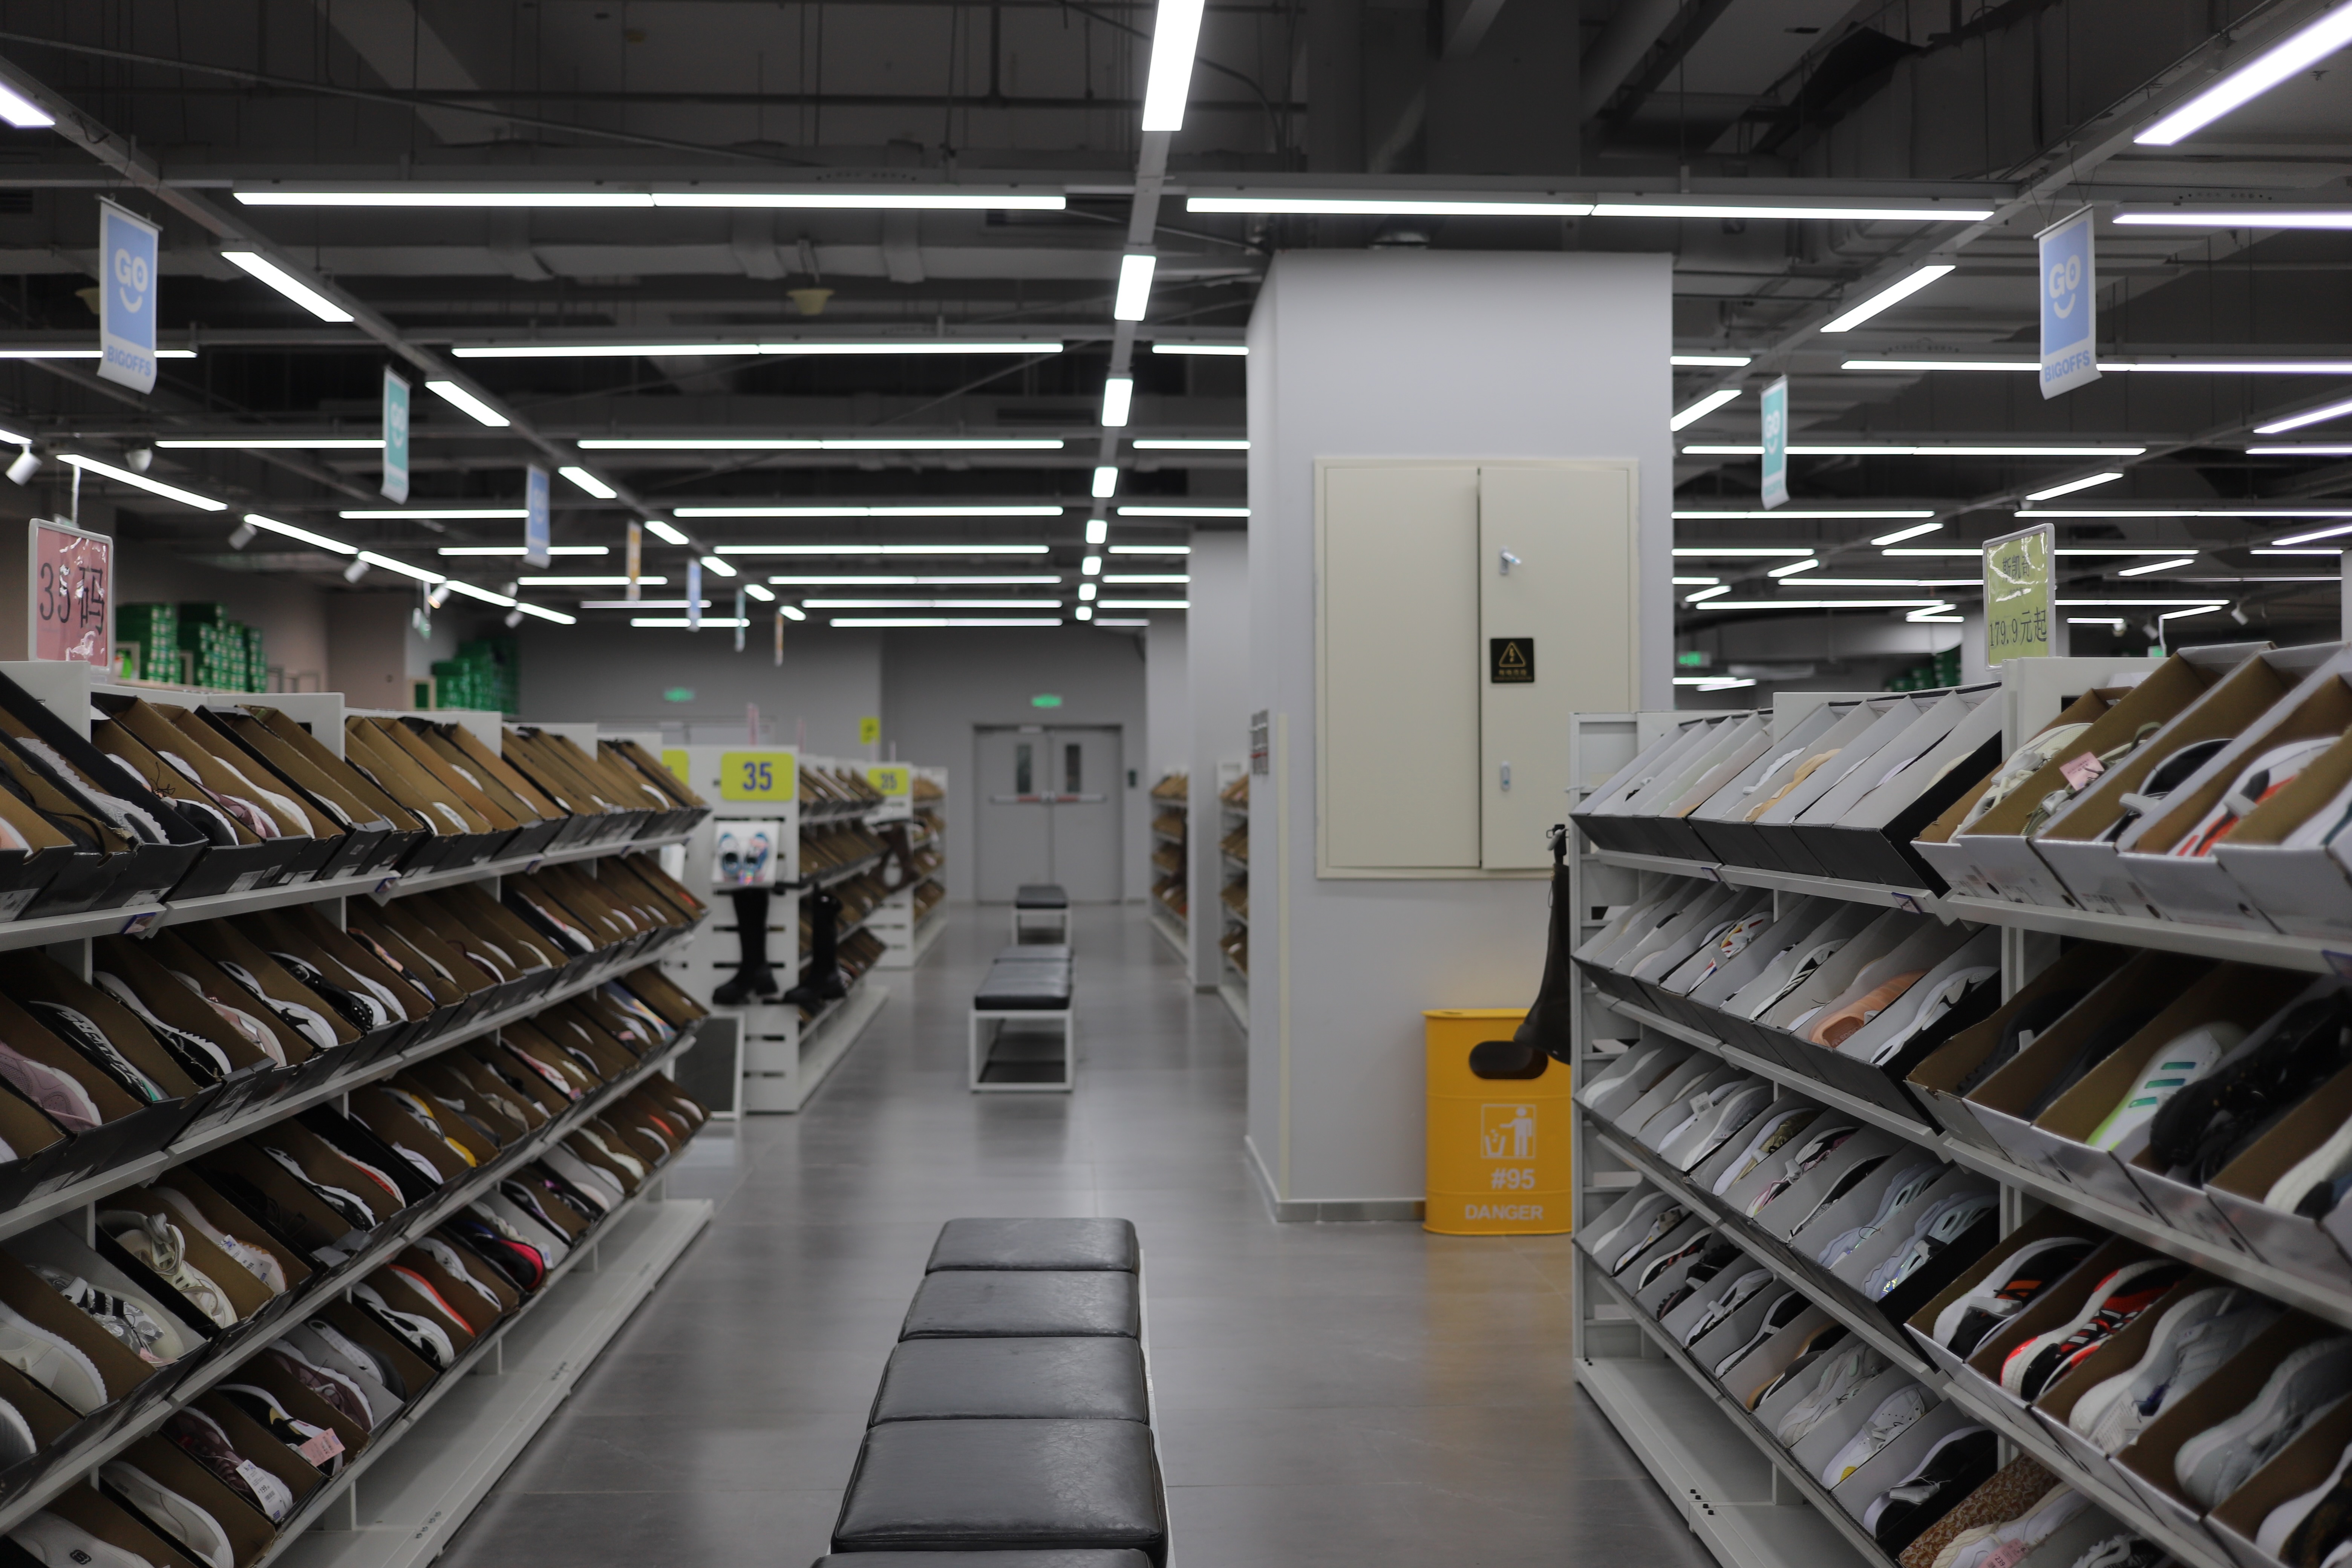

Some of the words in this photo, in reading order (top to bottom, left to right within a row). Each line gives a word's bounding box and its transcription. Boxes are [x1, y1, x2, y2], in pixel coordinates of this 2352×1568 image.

[115, 248, 148, 292] GO
[2049, 254, 2081, 299] GO
[107, 345, 152, 377] BIGOFFS
[2044, 350, 2091, 383] BIGOFFS
[743, 761, 772, 791] 35
[1491, 1168, 1536, 1190] #95
[1464, 1204, 1544, 1221] DANGER
